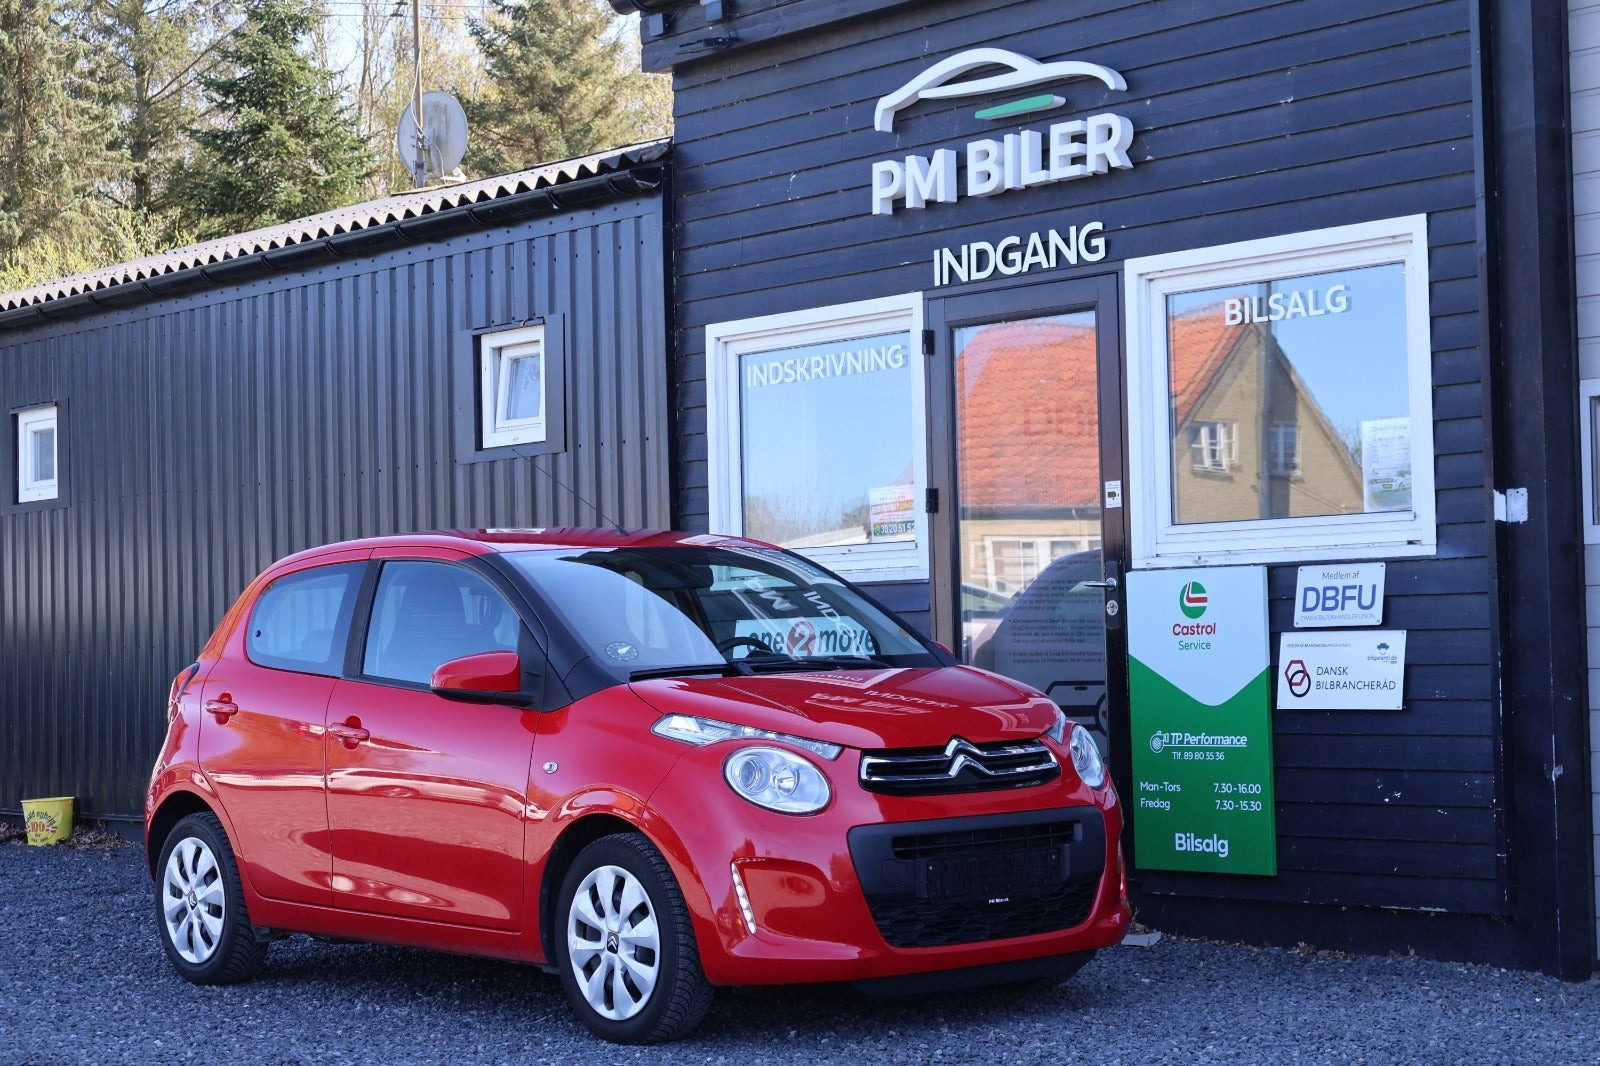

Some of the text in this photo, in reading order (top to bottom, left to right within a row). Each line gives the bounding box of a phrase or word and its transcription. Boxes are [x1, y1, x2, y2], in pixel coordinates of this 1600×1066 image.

[872, 113, 1134, 215] PM BILER
[933, 222, 1106, 286] INDGANG
[1225, 285, 1347, 326] BILSALG
[747, 344, 904, 388] INDSKRIVNING
[1322, 570, 1360, 581] Medlem af
[1302, 584, 1377, 612] DBFU
[1172, 622, 1216, 637] Castrol
[1178, 640, 1212, 651] Service
[1316, 666, 1349, 676] DANSK
[1316, 677, 1396, 690] BILBRANCHERÅD
[1171, 732, 1248, 745] TP Performance
[1172, 751, 1225, 760] Tlf. 89 80 35 36
[1140, 797, 1171, 811] Fredag
[1175, 832, 1229, 858] Bilsalg
